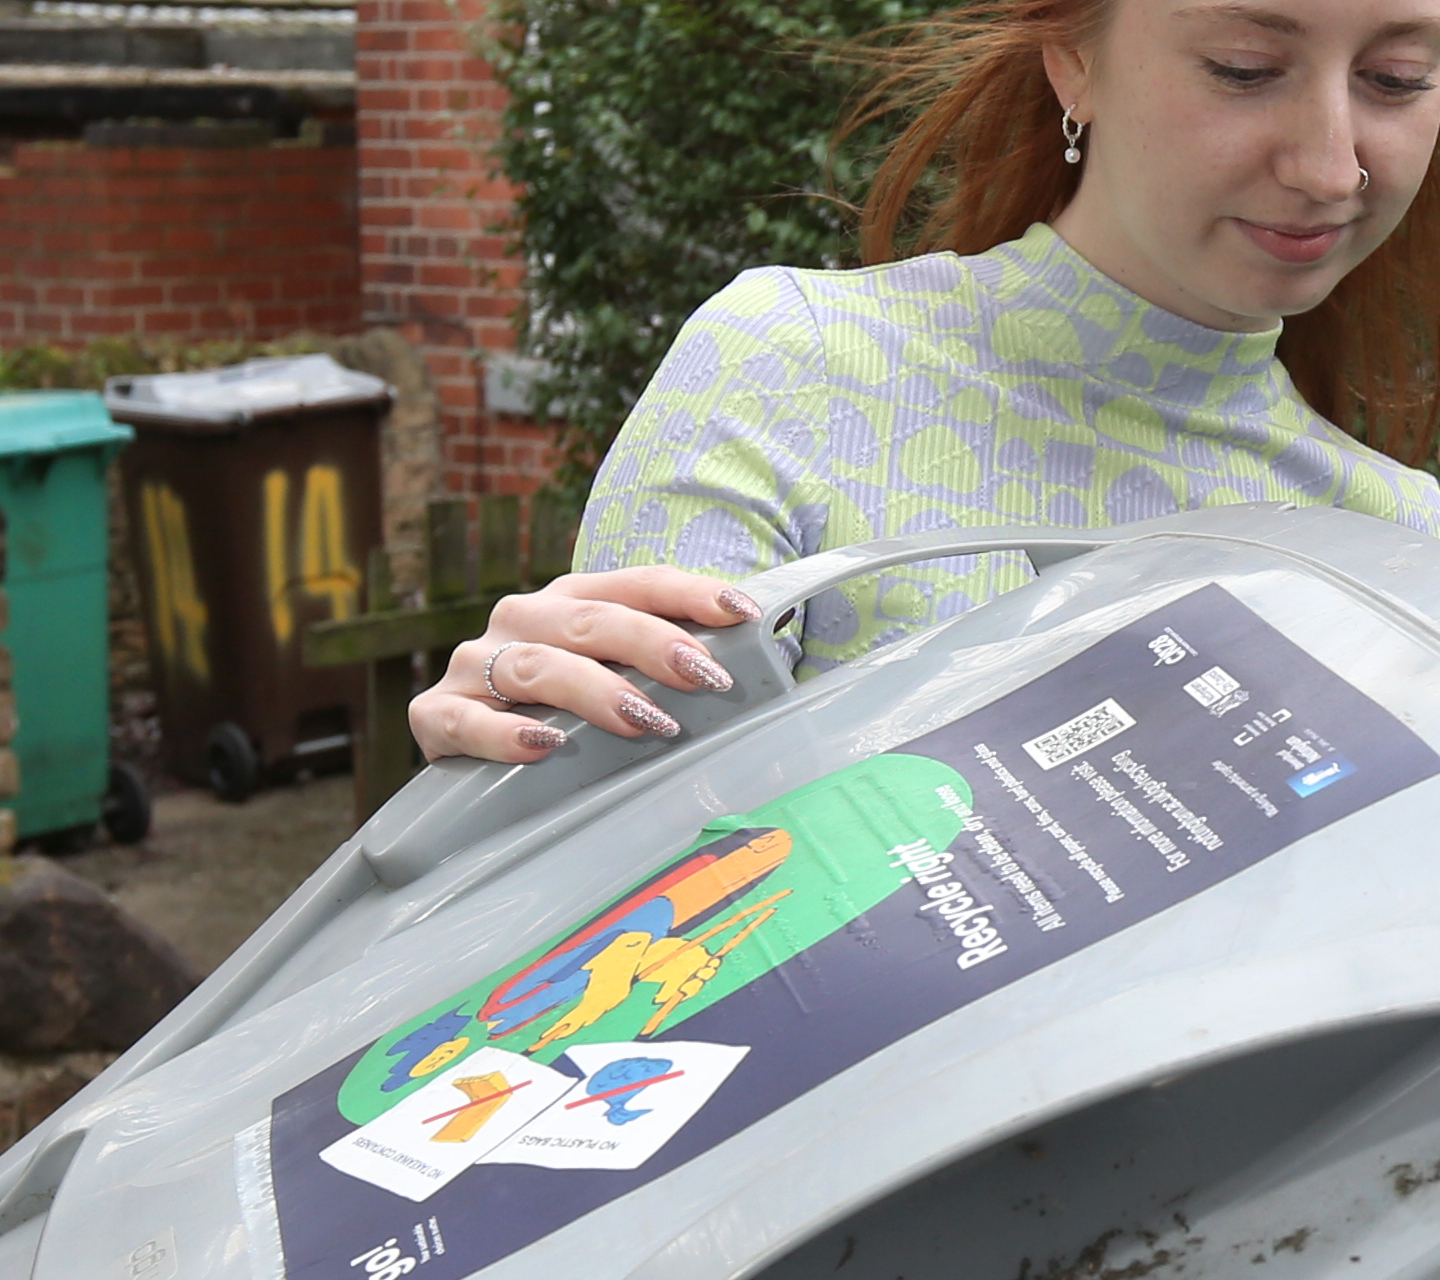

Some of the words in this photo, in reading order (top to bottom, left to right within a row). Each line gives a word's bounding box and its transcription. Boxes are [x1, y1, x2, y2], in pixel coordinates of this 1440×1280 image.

[1148, 634, 1185, 666] CN28
[973, 742, 997, 759] glass
[980, 756, 1002, 769] and
[1070, 760, 1097, 780] visit:
[993, 766, 1023, 790] plastics
[1088, 775, 1125, 801] please
[934, 784, 961, 808] loose
[1006, 784, 1029, 801] hard
[1112, 750, 1221, 849] nottingham.ac.uk/go/recycling
[949, 802, 973, 818] and
[1110, 797, 1157, 839] information
[960, 815, 984, 831] dry
[974, 828, 1003, 855] clean,
[1147, 831, 1176, 854] more
[887, 838, 953, 883] right
[991, 851, 1012, 867] be
[1068, 850, 1088, 861] all
[1165, 850, 1190, 872] For
[1000, 862, 1019, 875] to
[1077, 857, 1106, 881] recycle
[1000, 870, 1035, 893] need
[1098, 877, 1124, 903] Please
[1024, 890, 1054, 920] items
[921, 881, 1006, 968] Recycle
[1036, 912, 1065, 931] All
[352, 1136, 396, 1158] CONTAINERS
[518, 1134, 551, 1146] BAGS
[550, 1137, 596, 1148] PLASTIC
[598, 1140, 618, 1150] NO
[392, 1153, 428, 1174] TAKEAWAY
[426, 1168, 442, 1179] NO
